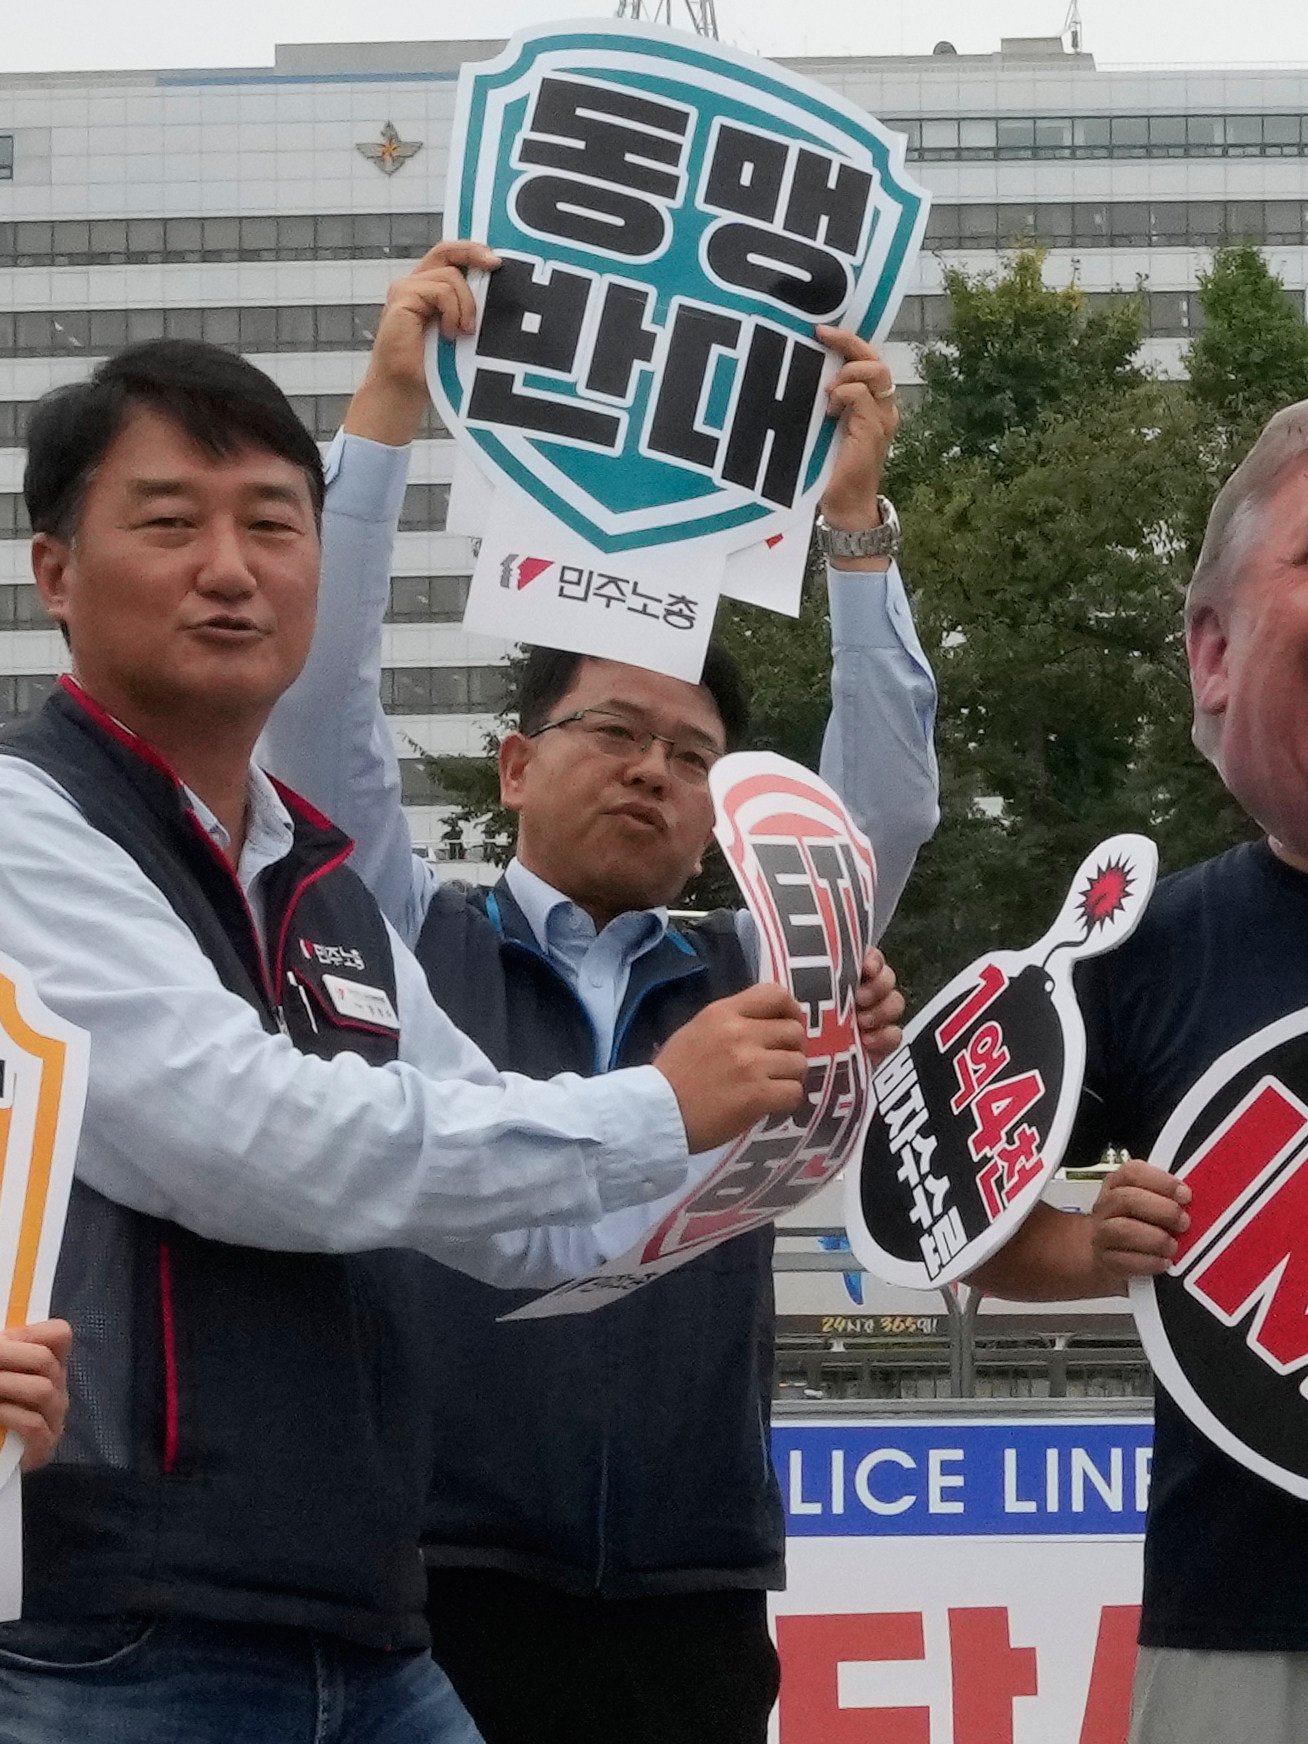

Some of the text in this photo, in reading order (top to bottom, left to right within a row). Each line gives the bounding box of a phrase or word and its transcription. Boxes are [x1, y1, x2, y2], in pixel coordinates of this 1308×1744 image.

[515, 78, 873, 316] 동맹
[467, 259, 826, 509] 반대
[558, 565, 699, 630] 민주노총
[751, 842, 870, 1029] 투자
[872, 1042, 968, 1282] 비자수수료
[935, 962, 1046, 1225] 1억4천
